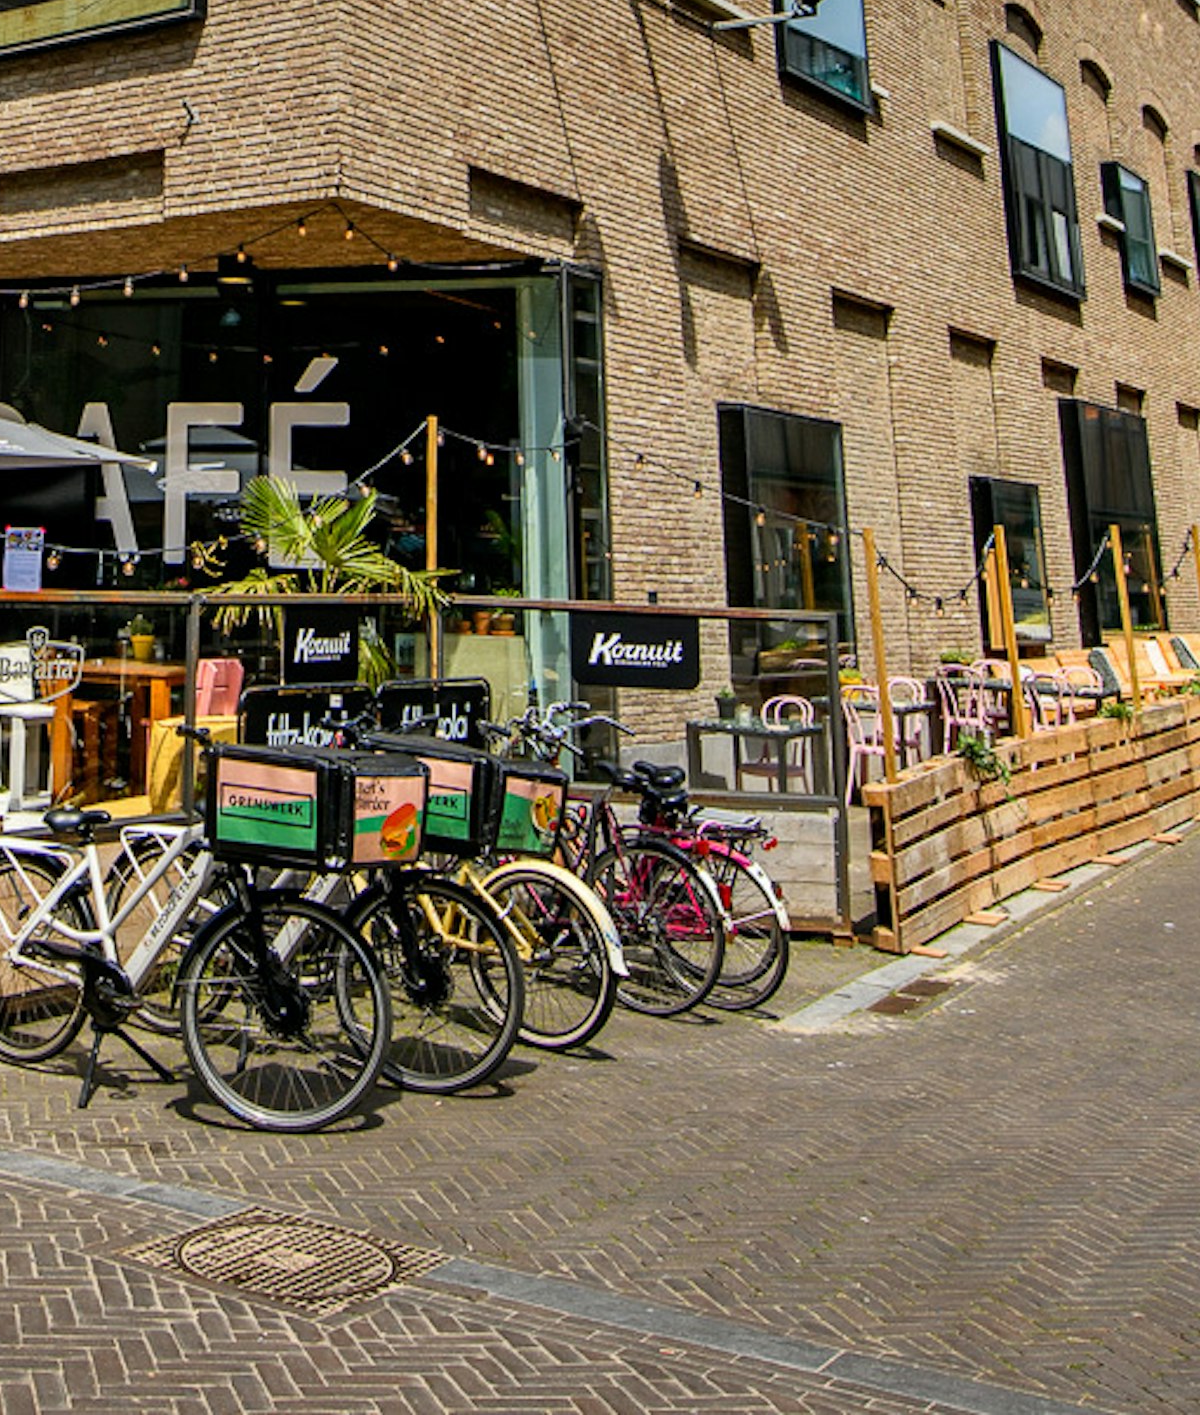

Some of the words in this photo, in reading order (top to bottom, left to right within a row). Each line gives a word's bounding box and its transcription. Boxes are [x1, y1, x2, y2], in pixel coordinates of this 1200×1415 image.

[294, 627, 351, 663] Kornuit
[588, 632, 683, 665] Kornuit
[229, 794, 304, 816] GRENSWERK
